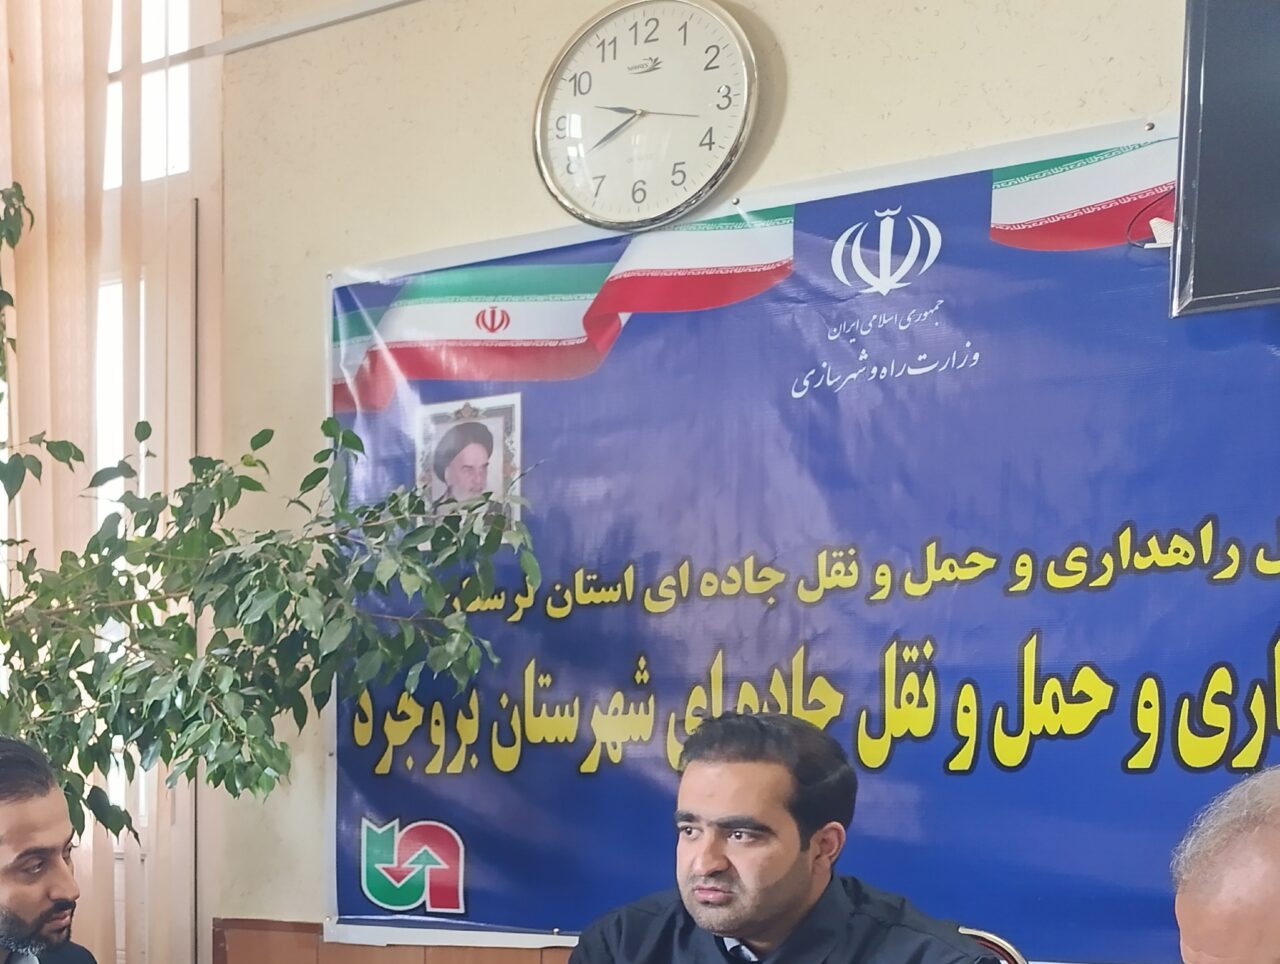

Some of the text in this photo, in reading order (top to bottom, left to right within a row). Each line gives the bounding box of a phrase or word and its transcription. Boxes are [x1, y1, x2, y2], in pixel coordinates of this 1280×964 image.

[596, 36, 617, 63] 11
[628, 17, 660, 46] 12
[677, 20, 689, 46] 1
[703, 44, 721, 71] 2
[568, 70, 593, 97] 10
[715, 84, 733, 110] 3
[698, 126, 716, 151] 4
[592, 174, 607, 198] 7
[631, 179, 647, 204] 6
[670, 161, 687, 187] 5
[827, 299, 944, 343] جمهوری اسلامی ایران
[879, 359, 907, 380] راه
[907, 341, 980, 375] وزارت
[903, 541, 997, 597] حمل
[1008, 553, 1034, 592] و
[1045, 519, 1240, 589] راهداری
[546, 565, 635, 618] استان
[643, 561, 690, 614] ای
[699, 556, 786, 604] جاده
[797, 547, 860, 603] نقل
[870, 561, 892, 600] و
[491, 656, 656, 773] شهرستان
[856, 640, 936, 769] نقل
[993, 634, 1114, 767] حمل
[353, 687, 480, 774] بروجرد
[948, 683, 978, 771] و
[1127, 677, 1159, 769] و
